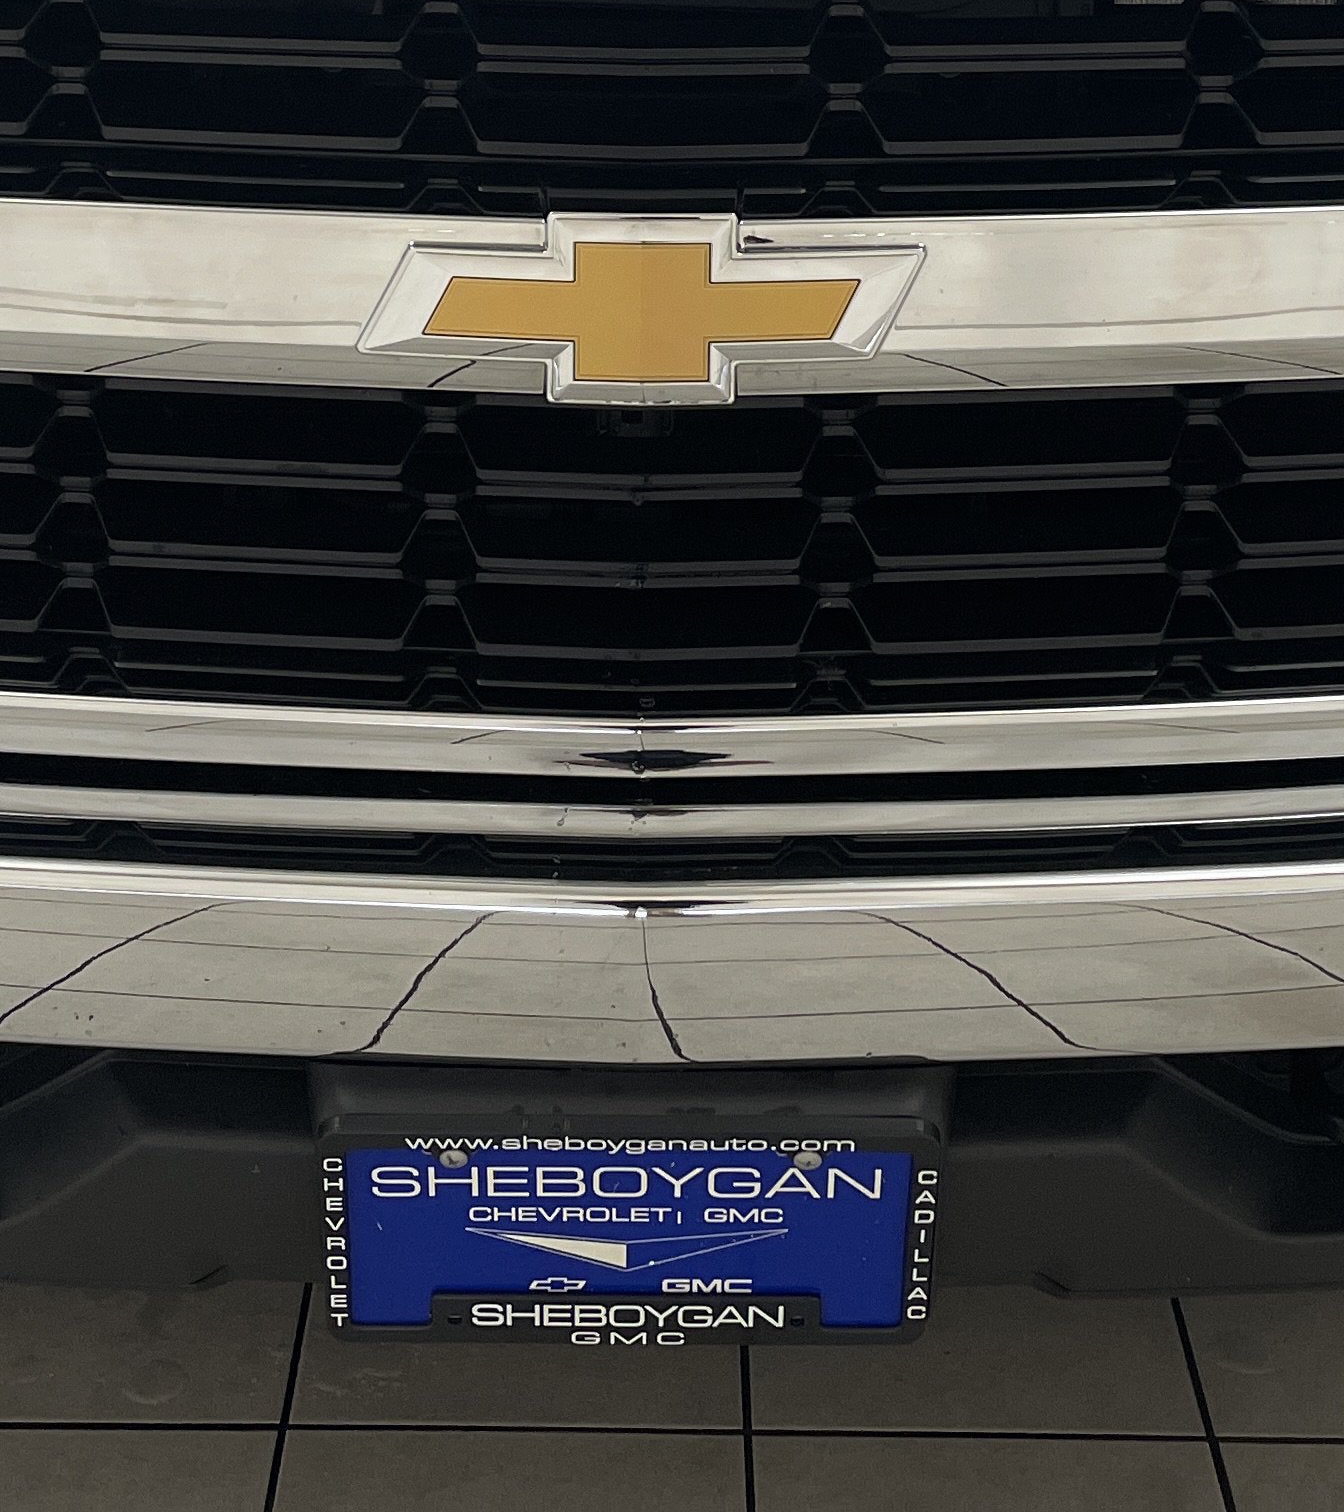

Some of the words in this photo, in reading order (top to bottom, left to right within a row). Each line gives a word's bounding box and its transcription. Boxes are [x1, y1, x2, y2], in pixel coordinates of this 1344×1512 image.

[404, 1135, 856, 1154] www.sheboyganauto.com
[370, 1166, 883, 1199] SHEBOYGAN
[468, 1206, 672, 1223] CHEVROLET
[703, 1207, 784, 1223] GMC
[322, 1157, 349, 1327] CHEVROLET
[906, 1170, 938, 1320] CADILLAC
[661, 1278, 753, 1293] GMC
[471, 1303, 785, 1328] SHEBOYGAN
[570, 1331, 685, 1346] GMC
